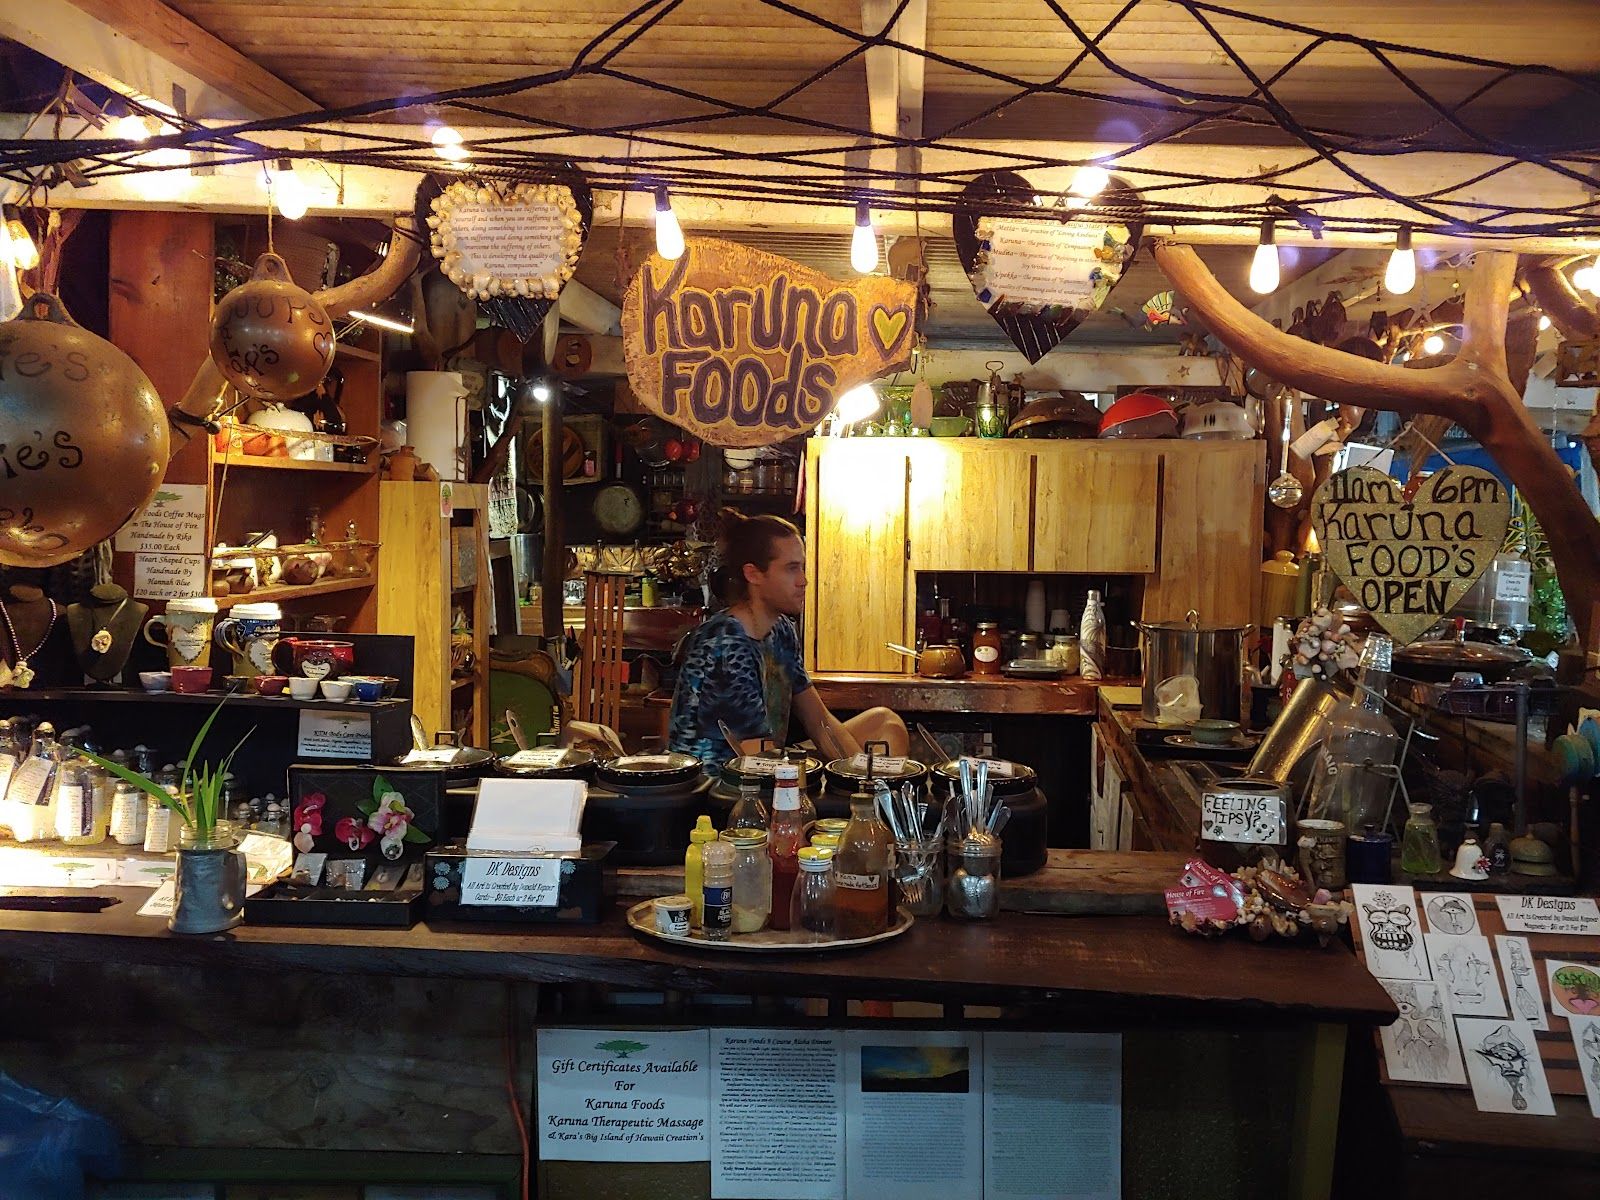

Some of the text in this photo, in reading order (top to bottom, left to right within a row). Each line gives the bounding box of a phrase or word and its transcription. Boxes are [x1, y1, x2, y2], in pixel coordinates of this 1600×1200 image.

[642, 245, 858, 358] Karuna
[662, 342, 838, 429] Foods
[164, 510, 184, 520] Coffee
[186, 511, 206, 520] Mugs
[175, 522, 182, 530] of
[1319, 503, 1483, 541] Karuna
[130, 532, 165, 540] Handmade
[166, 532, 174, 540] by
[159, 556, 182, 565] Shaped
[184, 558, 200, 566] Cups
[183, 568, 192, 576] By
[148, 578, 174, 586] Hannah
[179, 590, 188, 598] for
[1361, 579, 1452, 614] OPEN
[1204, 794, 1266, 811] FEELING
[486, 862, 541, 879] DK Designs
[1522, 897, 1576, 912] DK Designs
[552, 1059, 698, 1074] Gift Certificates Available
[614, 1080, 636, 1091] For
[585, 1098, 665, 1110] Karuna Foods
[548, 1116, 704, 1130] Karuna Therapeutic Massage
[558, 1132, 582, 1140] Kara's
[584, 1133, 598, 1142] Big
[600, 1133, 624, 1142] Island
[626, 1134, 634, 1143] of
[635, 1134, 664, 1142] Hawaii
[666, 1132, 704, 1142] Creation's
